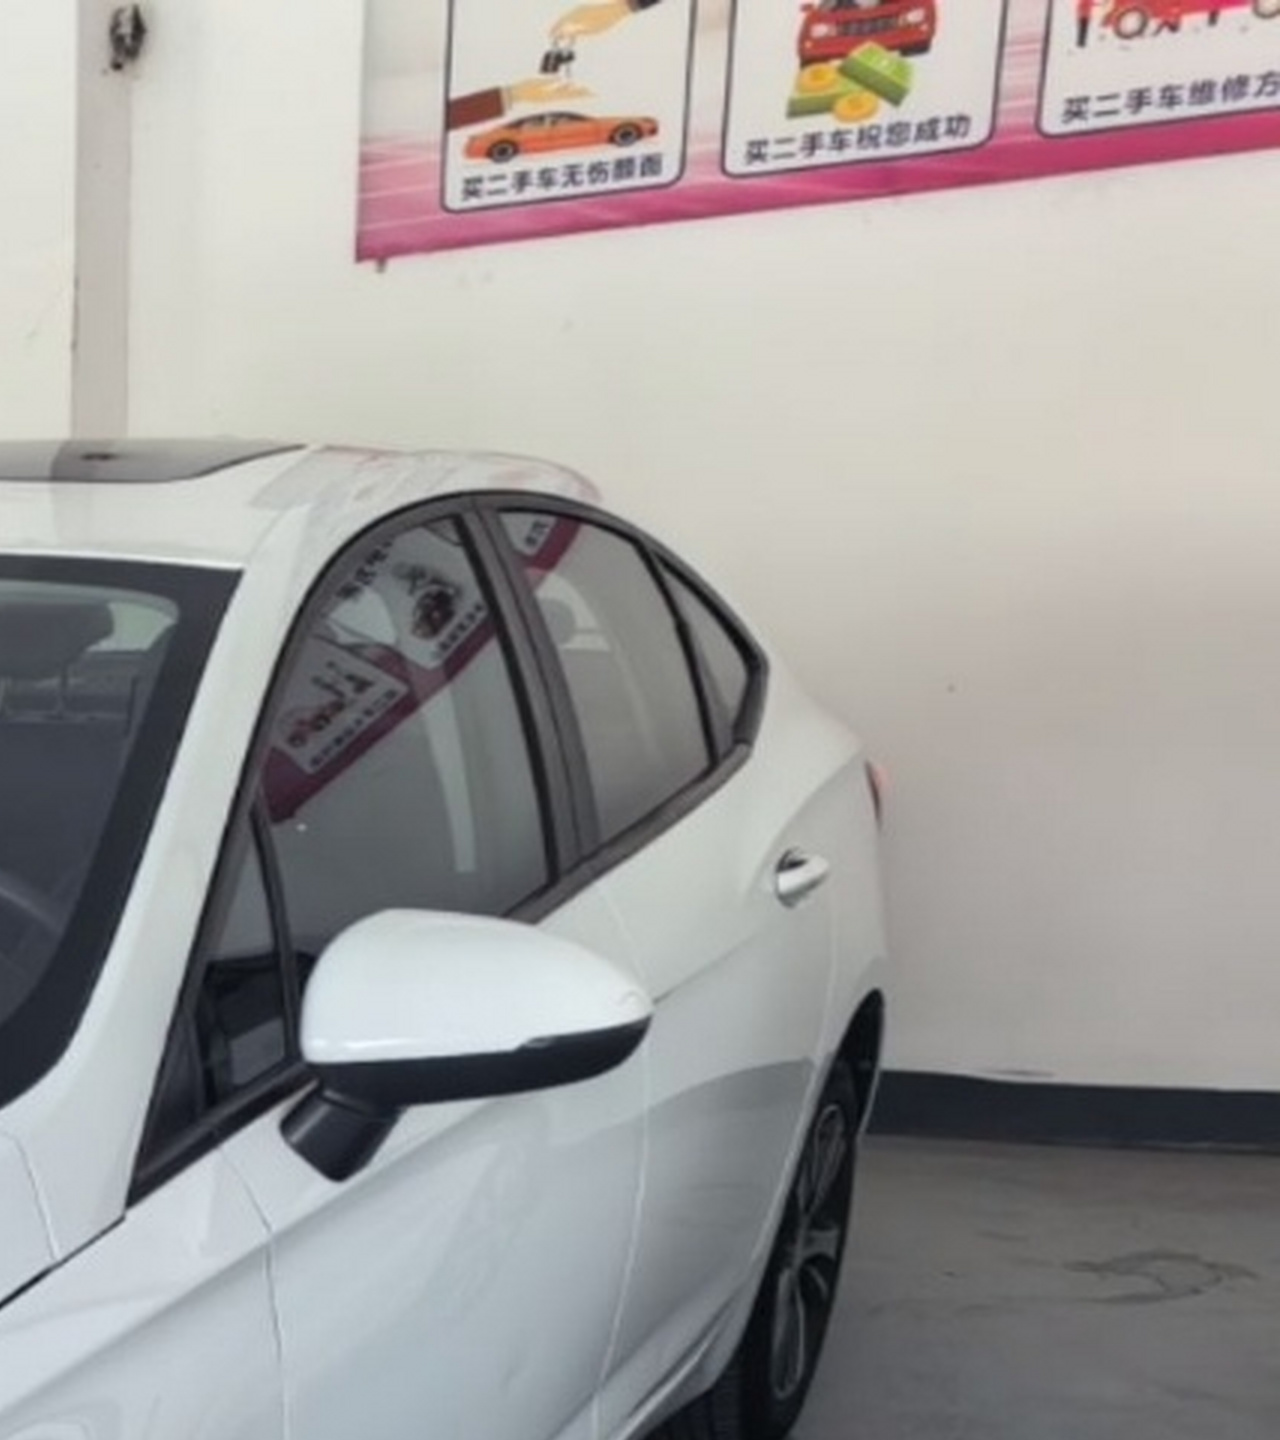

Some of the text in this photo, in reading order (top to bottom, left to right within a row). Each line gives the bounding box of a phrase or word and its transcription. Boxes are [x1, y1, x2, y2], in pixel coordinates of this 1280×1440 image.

[745, 114, 971, 165] 买二手车祝您成功
